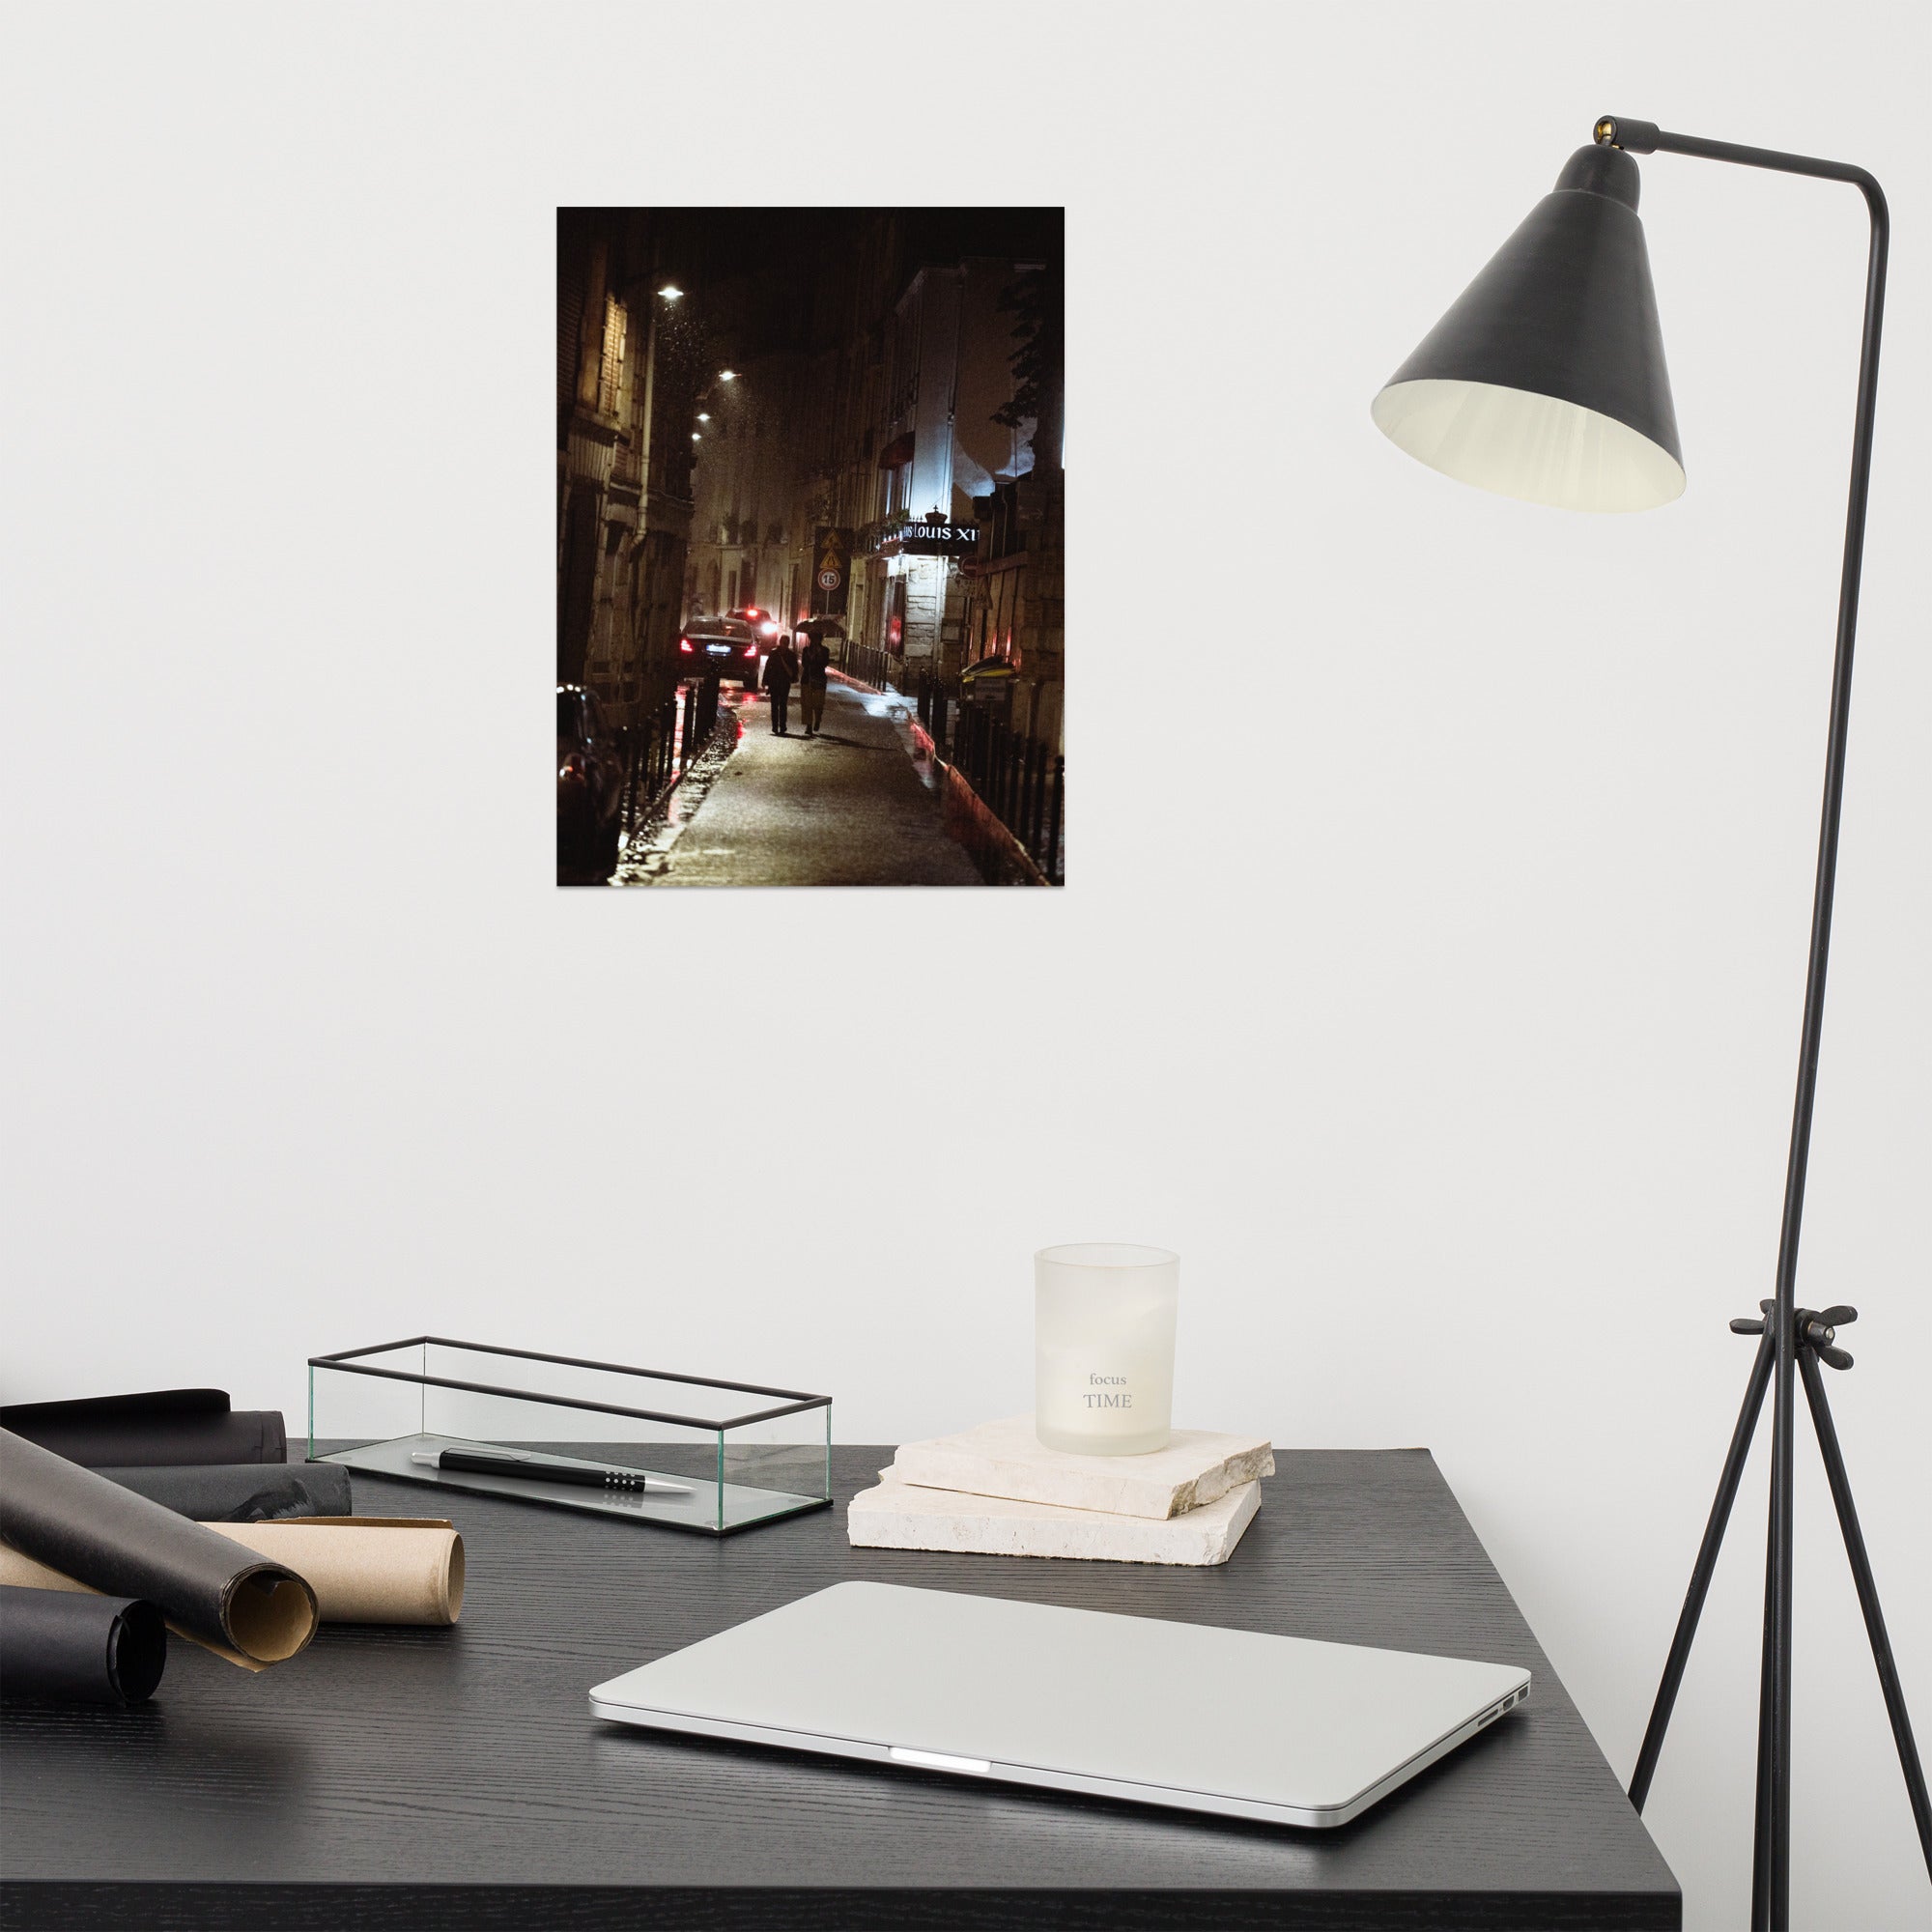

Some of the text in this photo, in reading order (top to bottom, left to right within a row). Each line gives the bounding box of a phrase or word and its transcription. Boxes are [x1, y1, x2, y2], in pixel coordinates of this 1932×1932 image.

[823, 575, 836, 584] 15
[1089, 1373, 1127, 1385] focus
[1082, 1394, 1132, 1408] TIME
